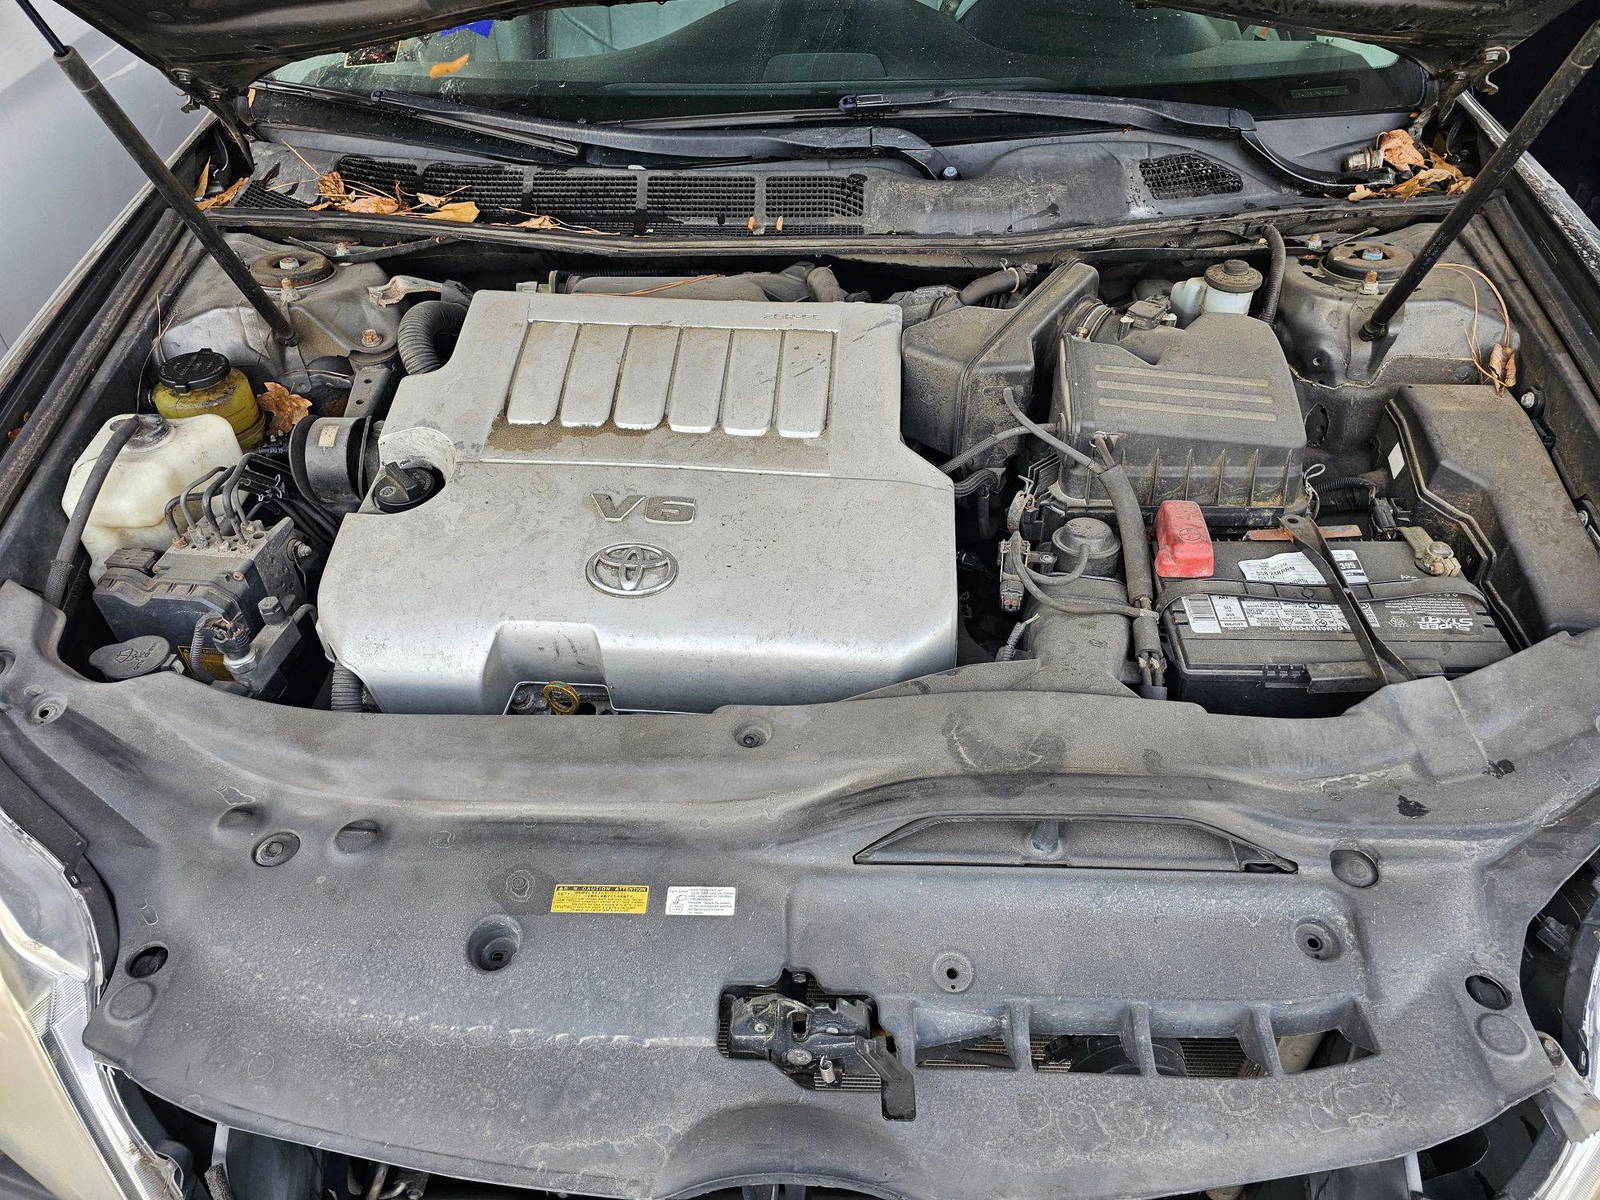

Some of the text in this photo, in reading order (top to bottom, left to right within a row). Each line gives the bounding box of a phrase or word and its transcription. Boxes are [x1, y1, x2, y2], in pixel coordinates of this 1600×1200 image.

[591, 493, 696, 525] V6
[1417, 616, 1473, 626] START
[1419, 623, 1471, 631] SUPER
